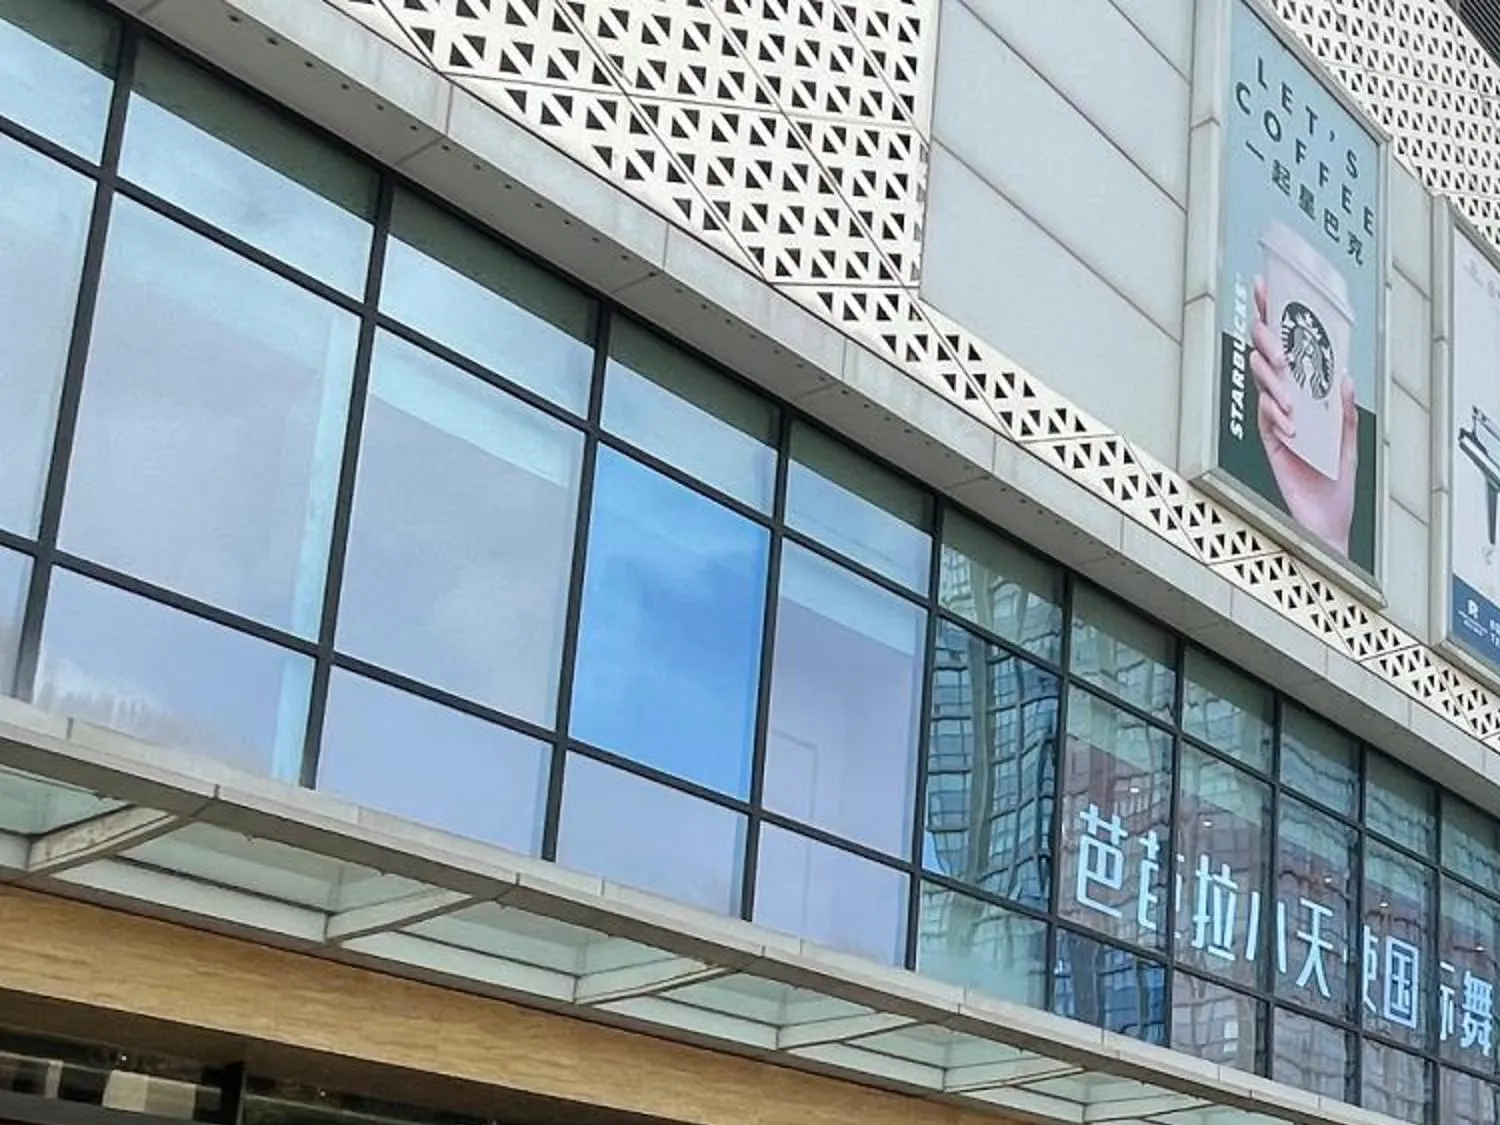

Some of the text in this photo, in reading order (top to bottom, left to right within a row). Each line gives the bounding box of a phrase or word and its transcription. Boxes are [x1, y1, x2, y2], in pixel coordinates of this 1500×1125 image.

[1236, 81, 1375, 237] COFFEE
[1245, 140, 1364, 266] 一起星巴克
[1229, 273, 1250, 441] STARBUCKS
